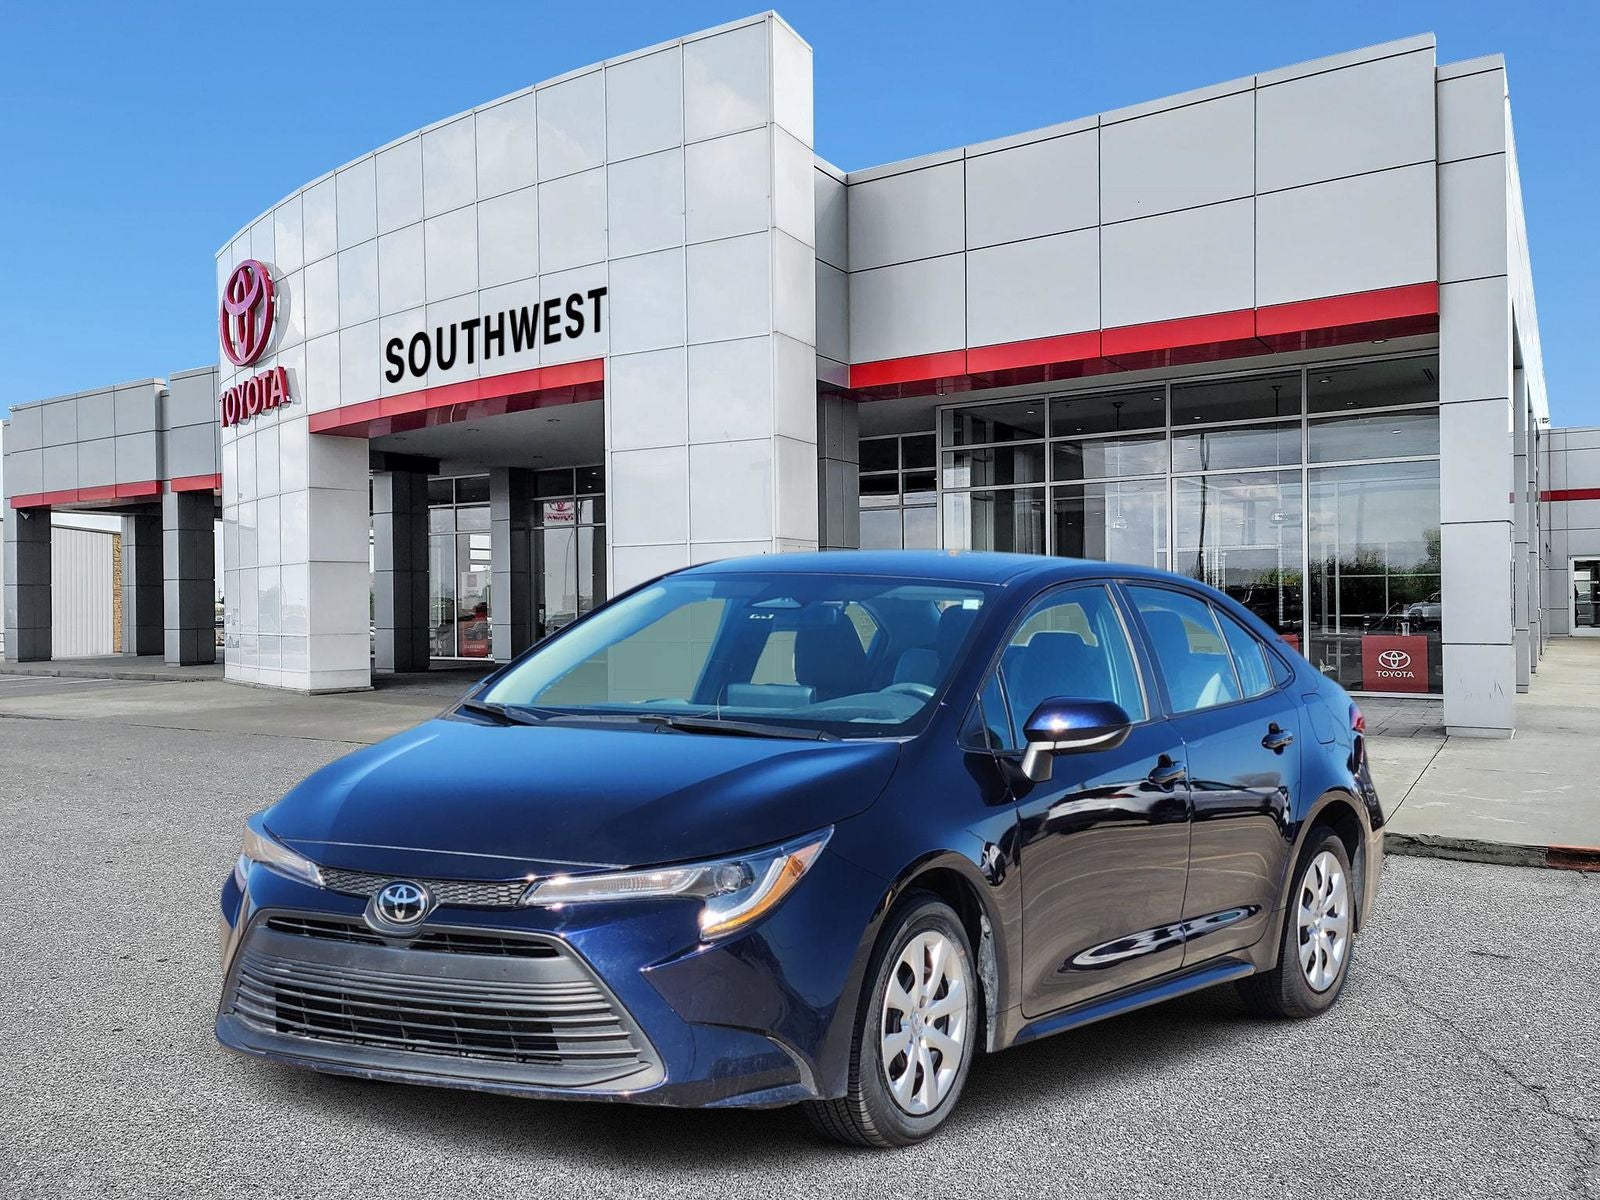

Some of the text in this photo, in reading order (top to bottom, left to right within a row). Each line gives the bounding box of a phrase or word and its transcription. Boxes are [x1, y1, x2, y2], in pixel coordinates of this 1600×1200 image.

[385, 286, 608, 384] SOUTHWEST
[218, 366, 290, 428] TOYOTA
[1376, 670, 1415, 678] TOYOTA
